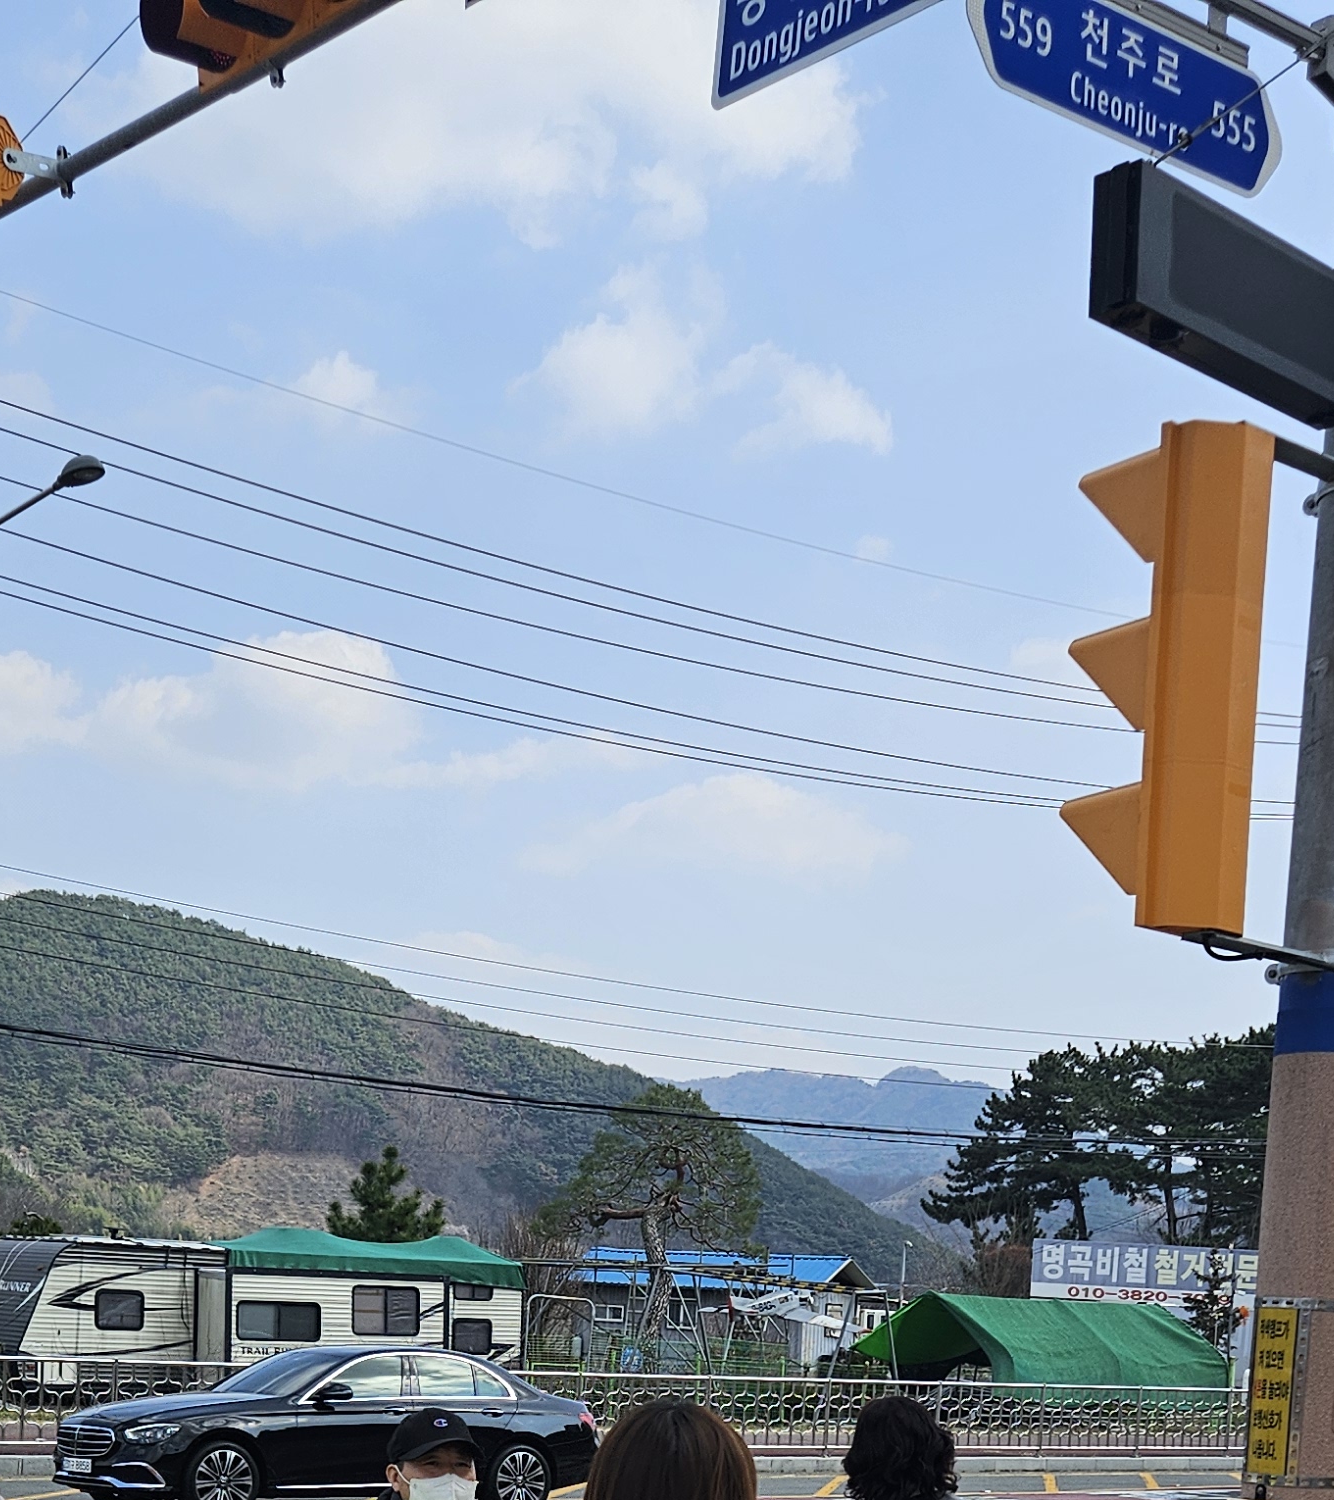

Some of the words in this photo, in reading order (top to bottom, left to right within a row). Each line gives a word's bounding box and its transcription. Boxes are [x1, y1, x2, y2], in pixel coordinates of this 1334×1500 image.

[999, 0, 1053, 57] 559
[1080, 9, 1182, 96] 천주로
[1211, 100, 1257, 152] 555
[1042, 1244, 1148, 1284] 명곡비철
